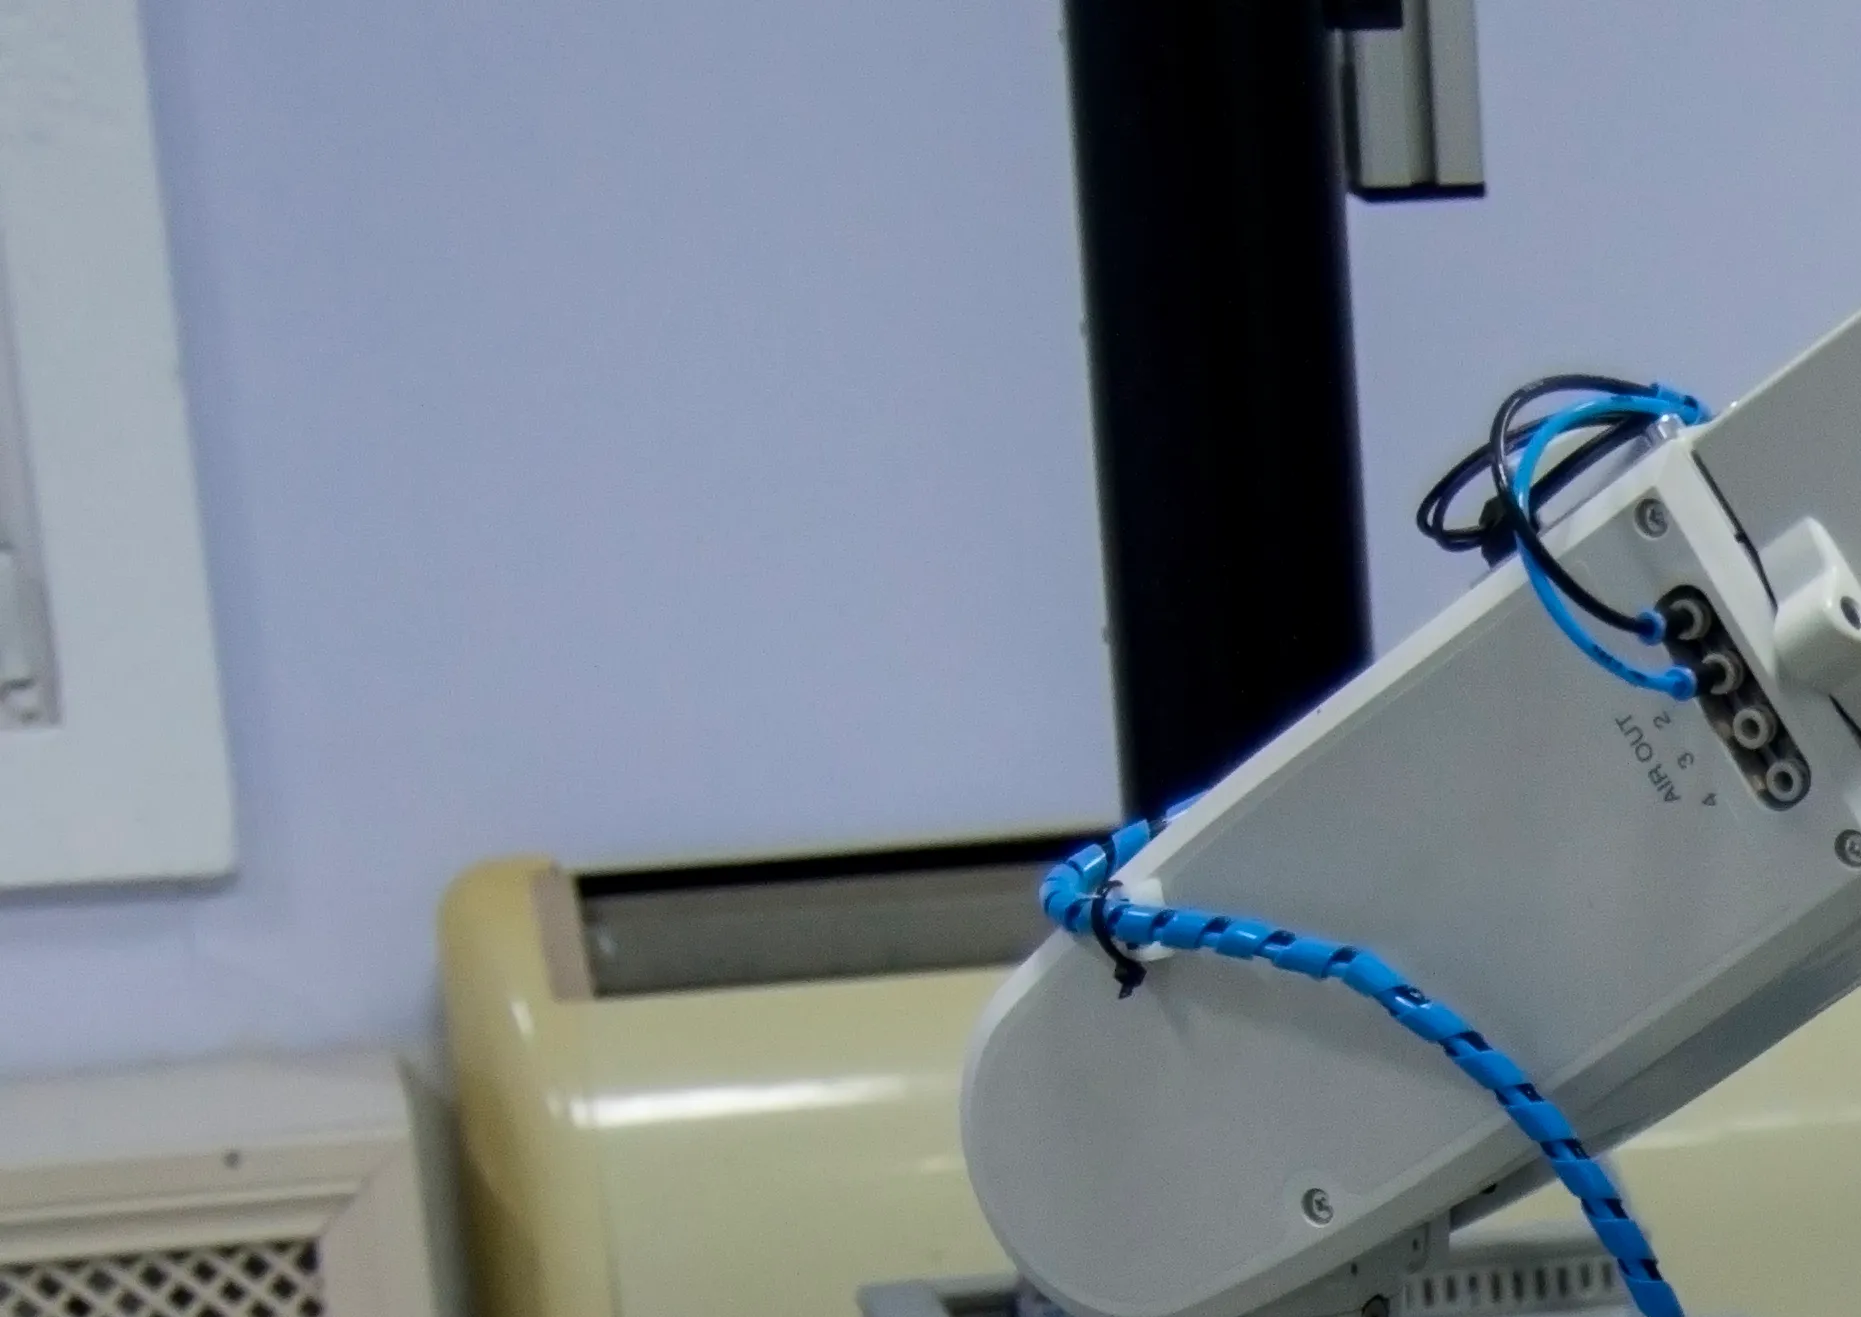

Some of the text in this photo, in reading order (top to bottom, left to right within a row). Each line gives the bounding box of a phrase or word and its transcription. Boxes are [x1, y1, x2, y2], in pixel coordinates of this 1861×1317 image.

[1614, 714, 1654, 763] OUT
[1652, 710, 1717, 807] 4 3 2
[1647, 763, 1682, 802] AIR
